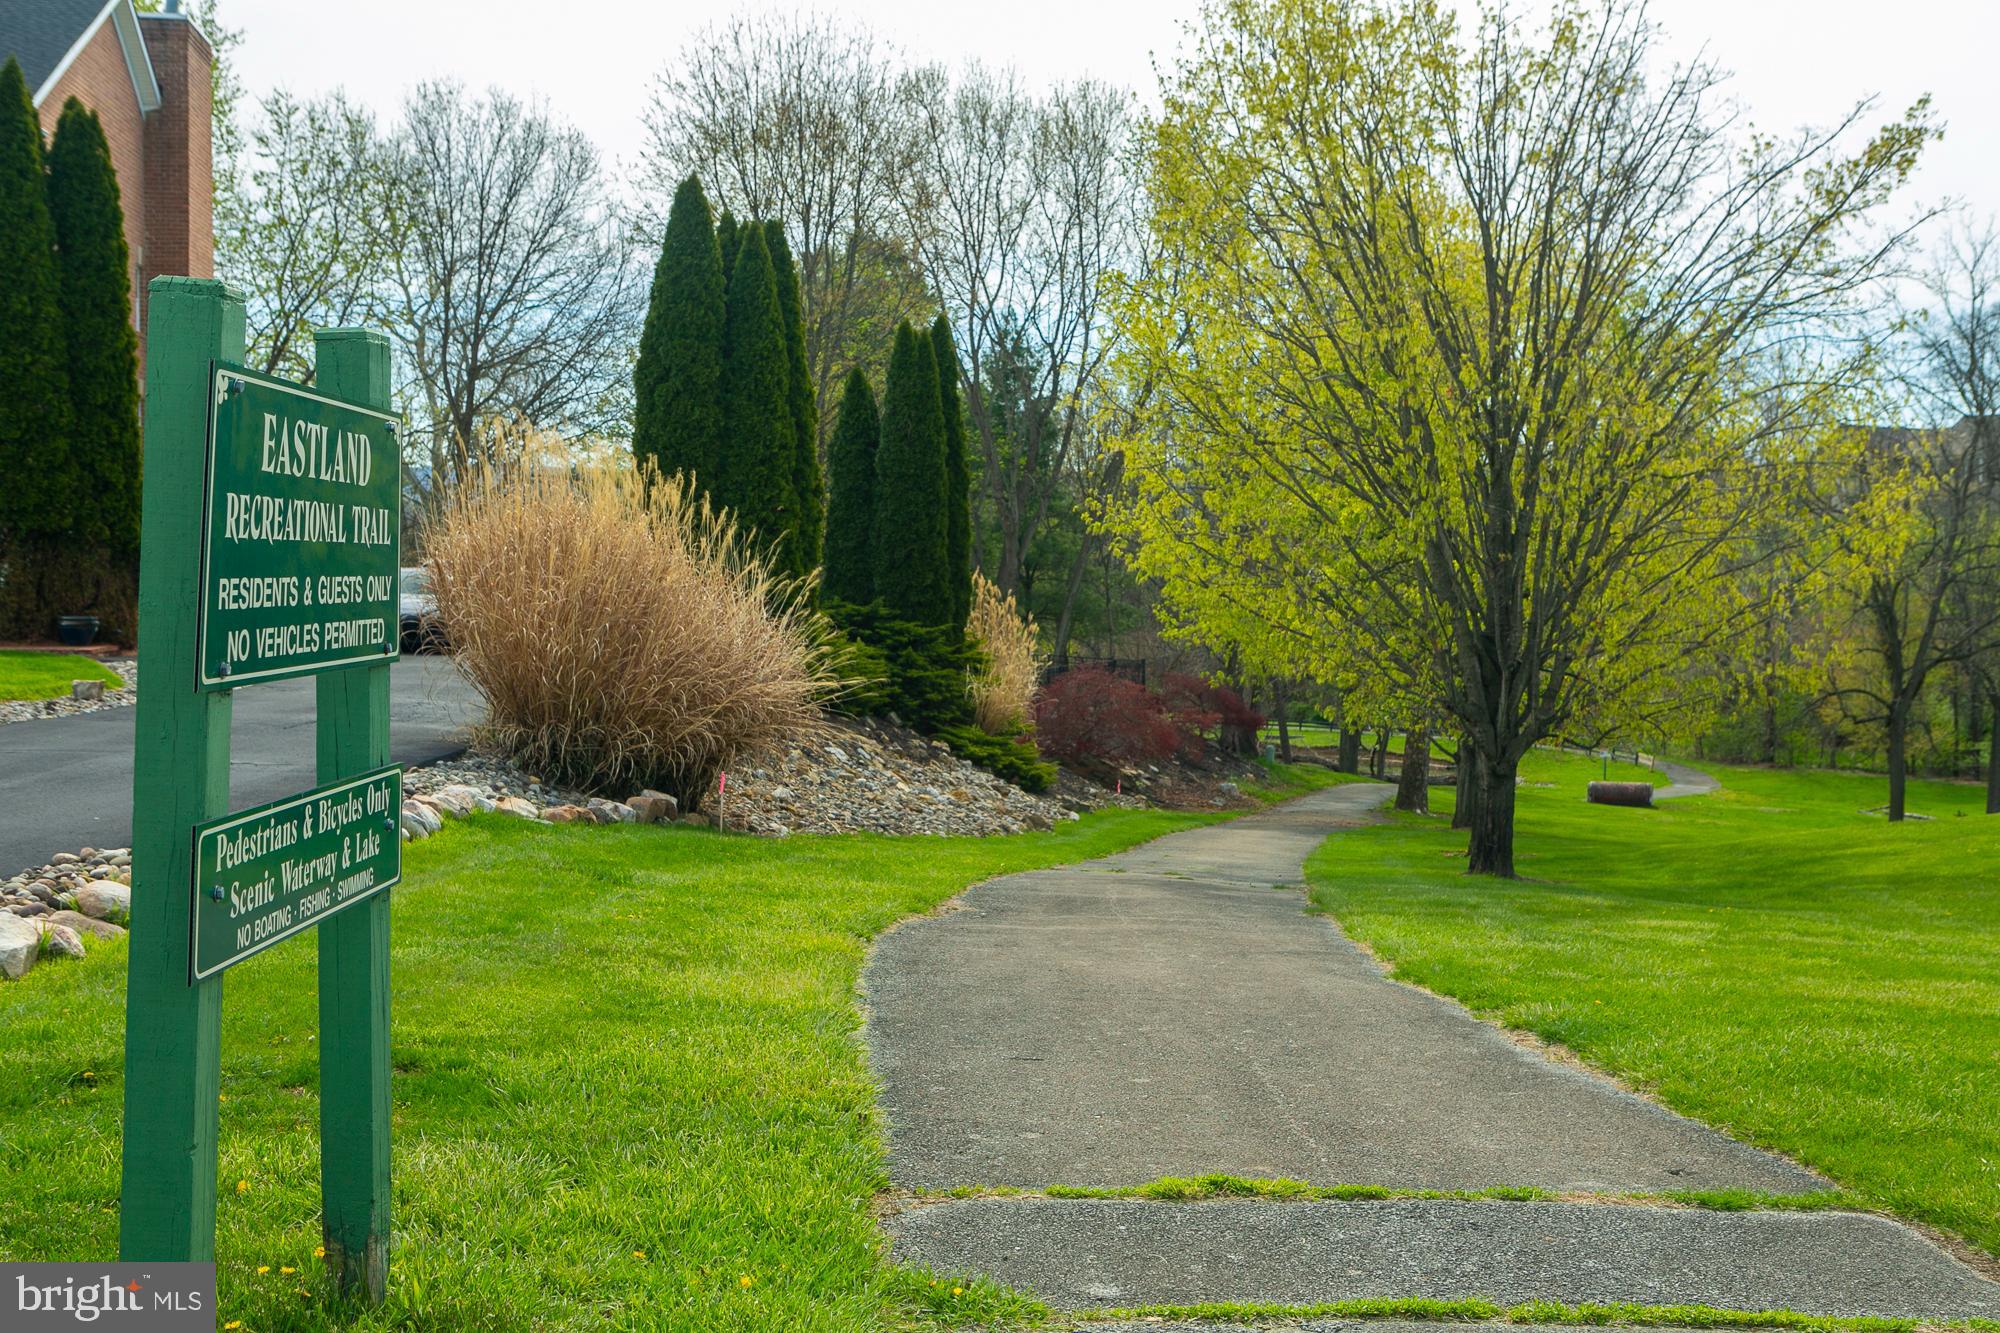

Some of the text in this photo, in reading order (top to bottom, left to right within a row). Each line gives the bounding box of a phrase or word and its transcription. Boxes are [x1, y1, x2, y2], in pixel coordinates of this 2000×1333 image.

[261, 413, 371, 486] EASTLAND
[225, 493, 391, 548] RECREATIONAL TRAIL
[218, 575, 392, 610] RESIDENTS & GUESTS ONLY
[227, 618, 385, 662] NO VEHICLES PERMITTED
[216, 781, 391, 872] Pedestrians & Bicycles Only
[230, 828, 380, 918] Scenic Waterway & Lake
[236, 867, 373, 950] NO BOATING FISHING SWIMMING
